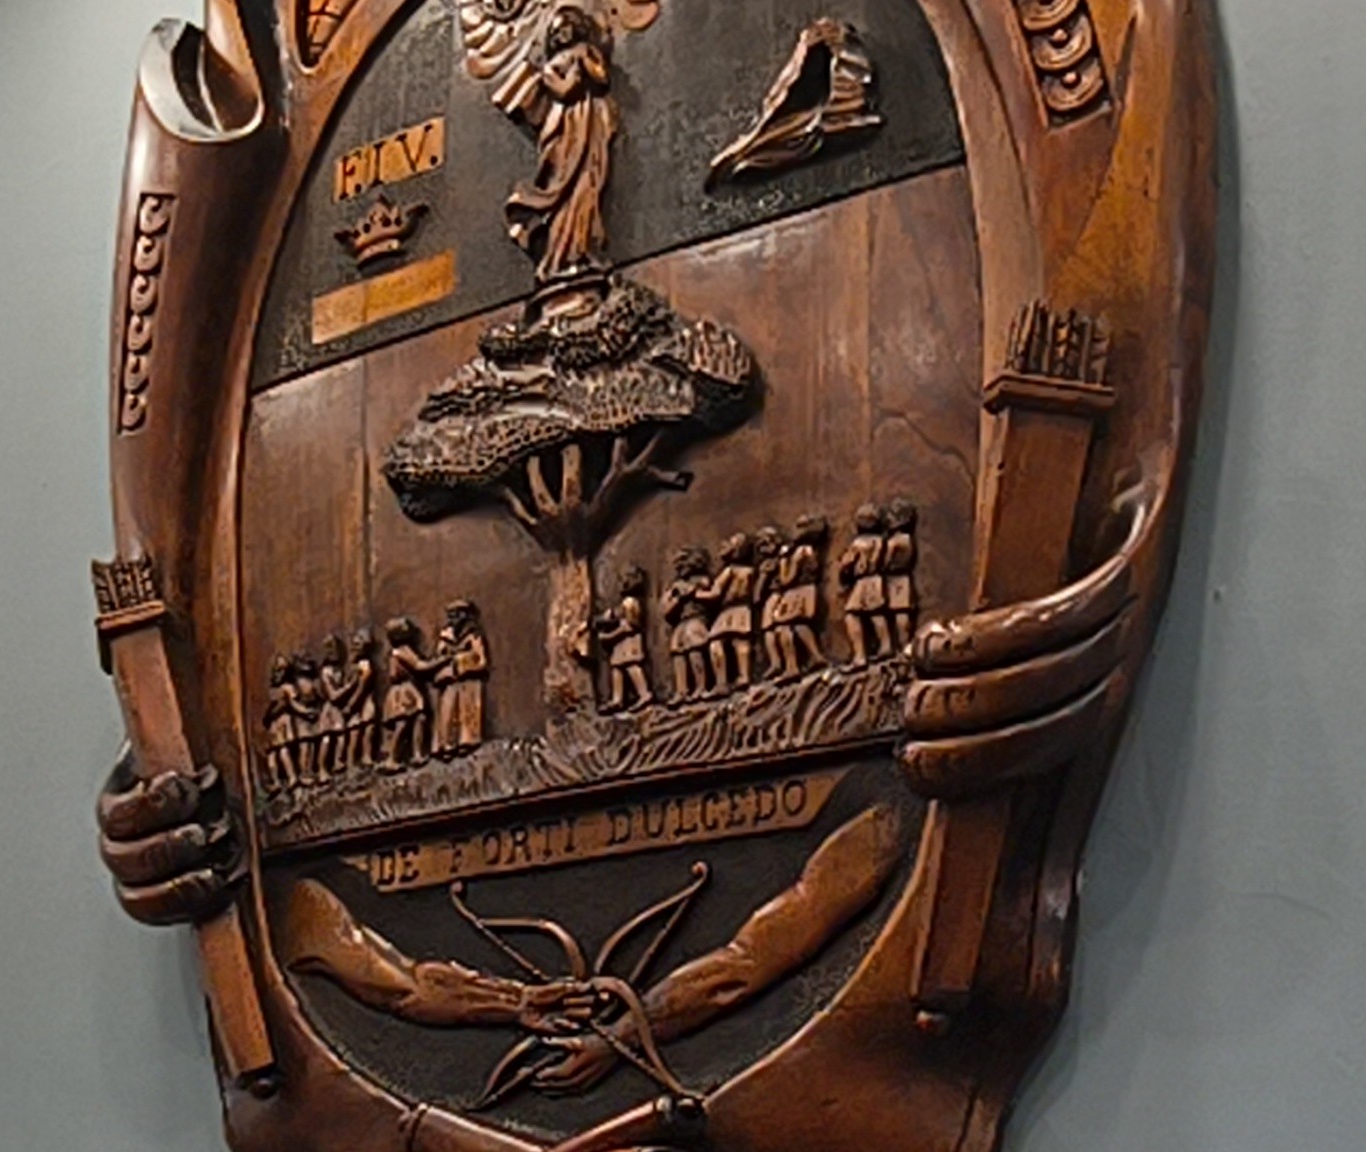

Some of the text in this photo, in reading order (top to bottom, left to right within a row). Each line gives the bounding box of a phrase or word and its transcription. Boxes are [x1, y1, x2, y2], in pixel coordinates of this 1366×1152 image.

[376, 779, 808, 886] DE FORTI DULCEDO
